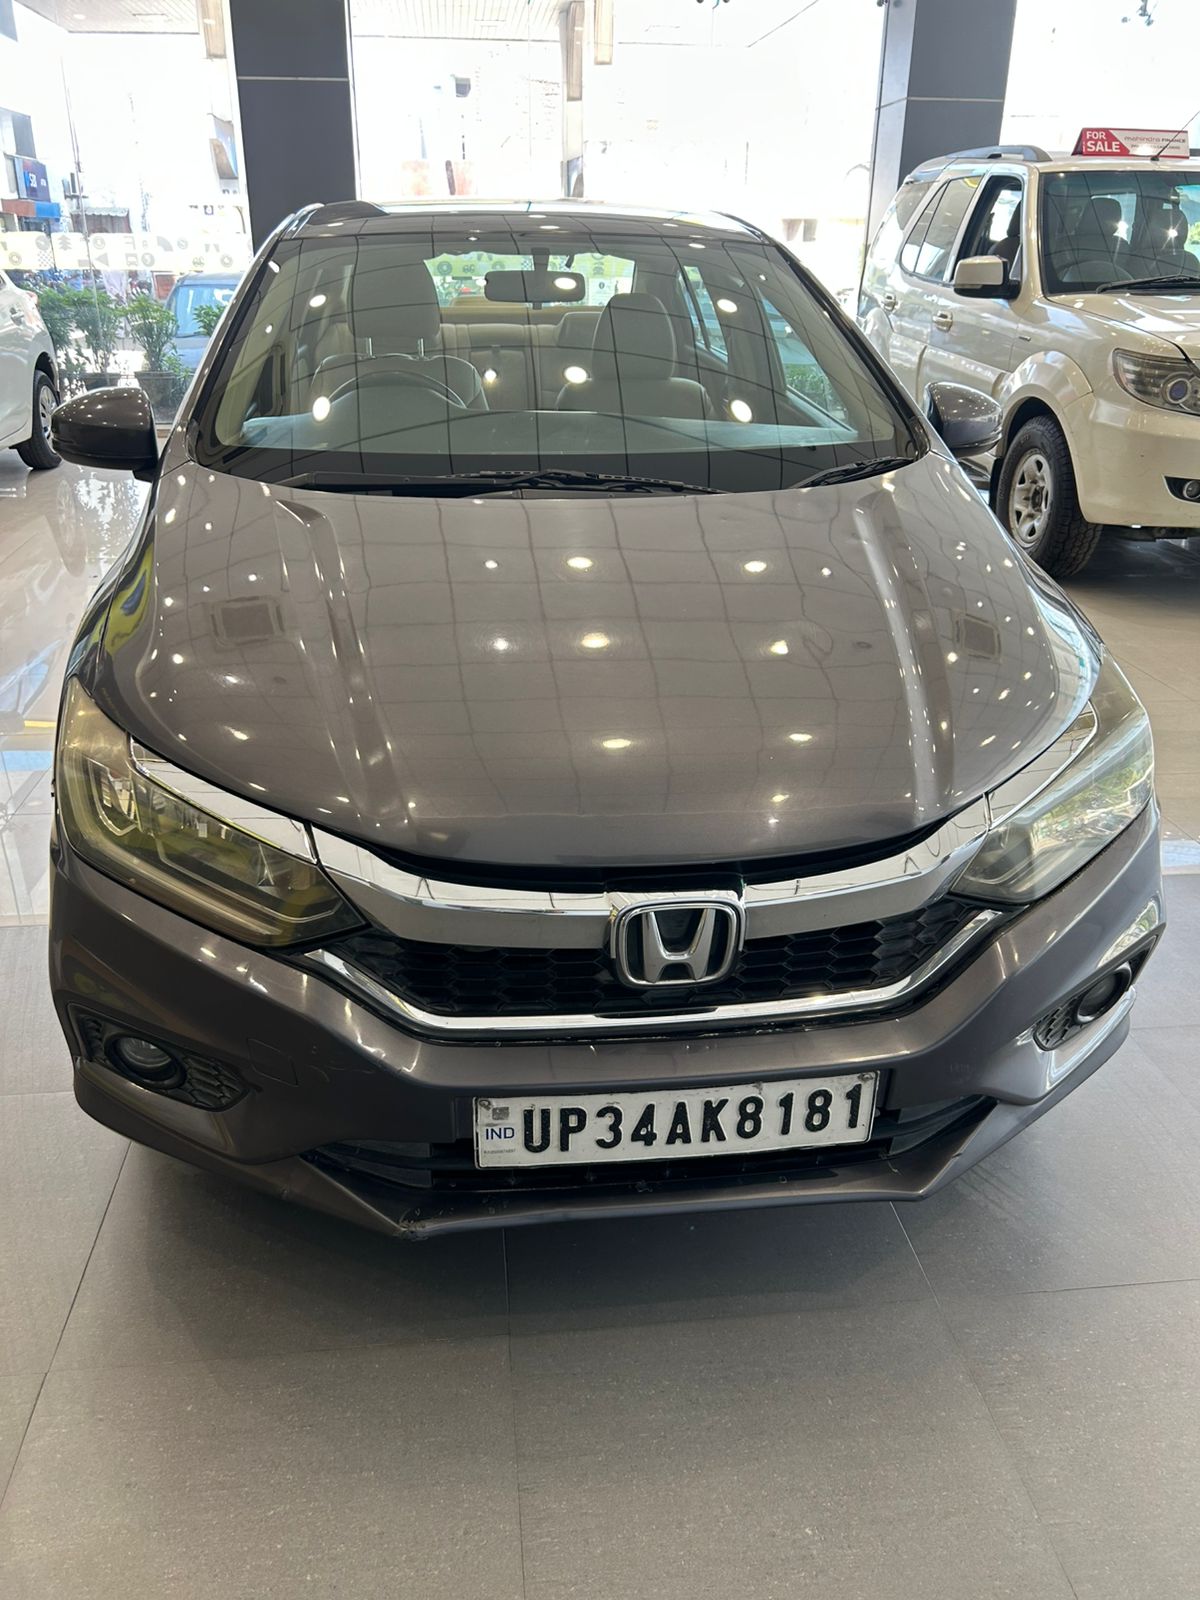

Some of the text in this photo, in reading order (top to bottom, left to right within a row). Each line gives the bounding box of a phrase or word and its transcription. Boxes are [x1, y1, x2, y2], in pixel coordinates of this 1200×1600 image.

[1086, 131, 1106, 140] FOR
[1086, 140, 1121, 152] SALE
[523, 1083, 863, 1153] UP34AK8181
[485, 1127, 515, 1140] IND
